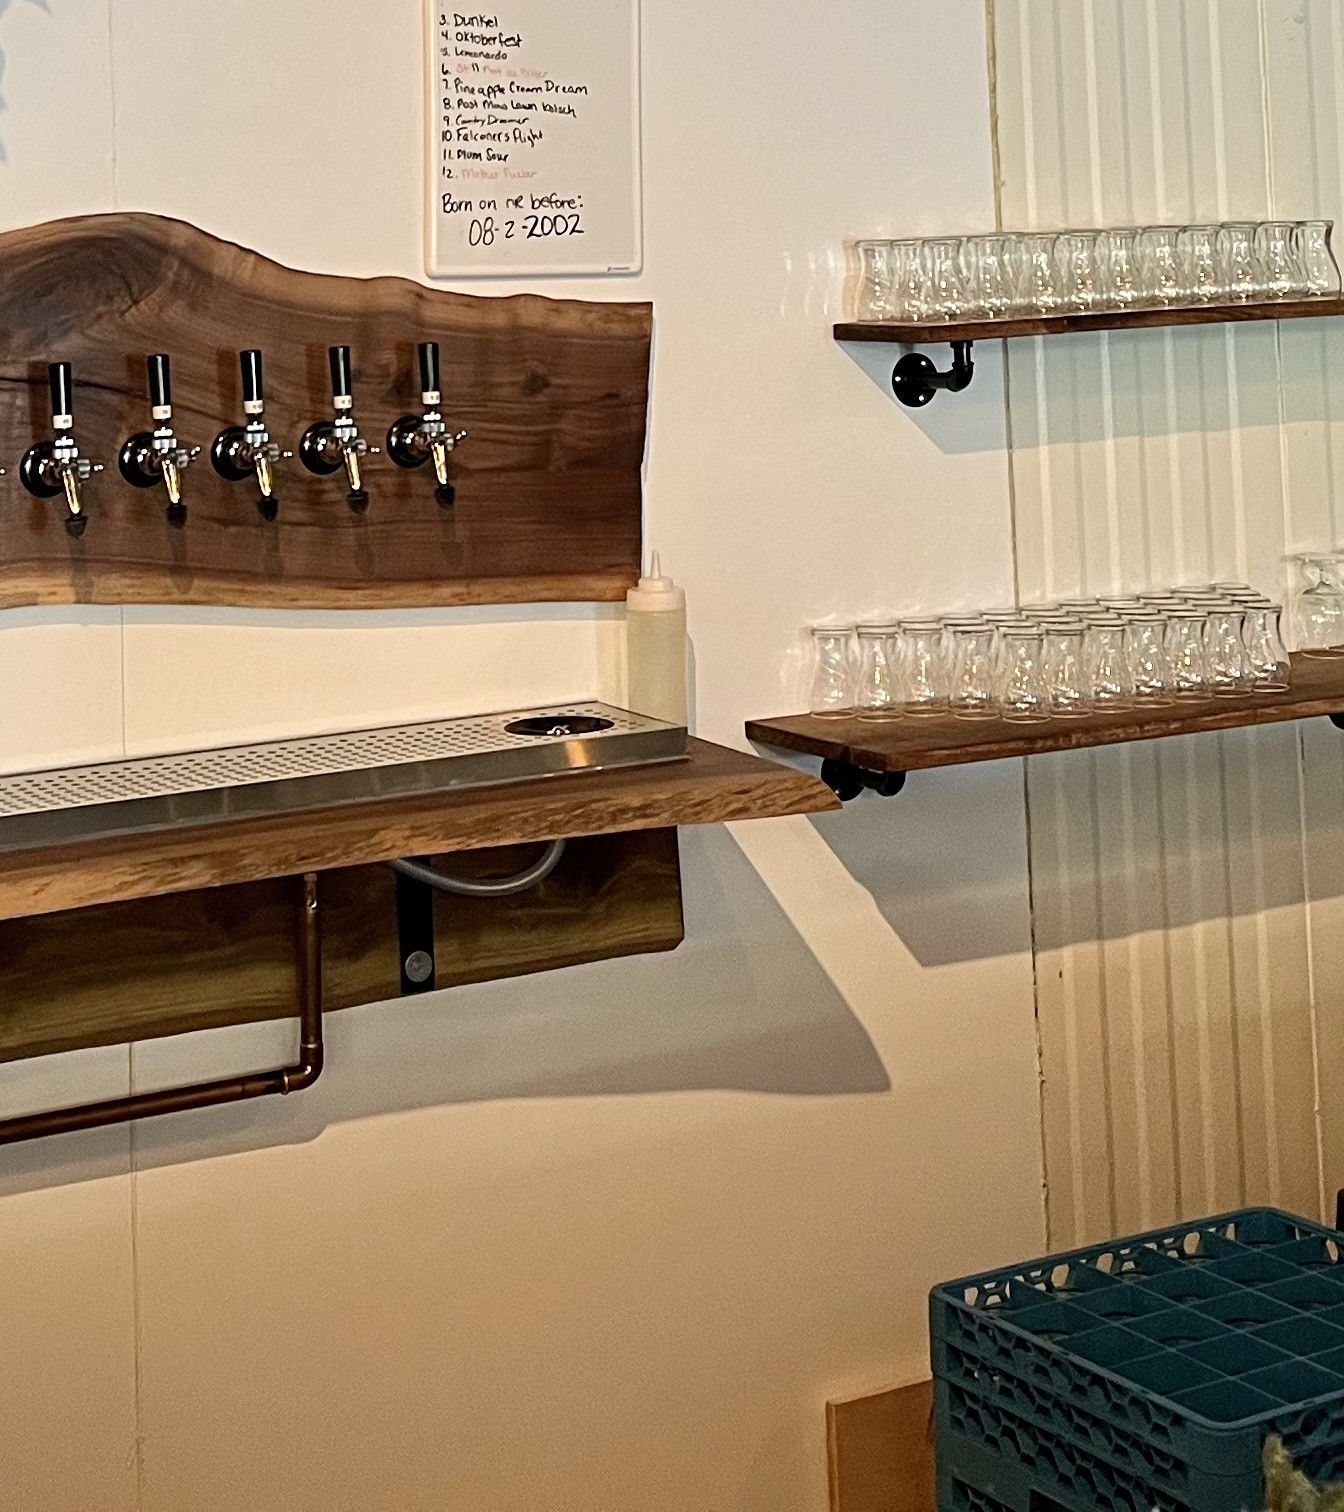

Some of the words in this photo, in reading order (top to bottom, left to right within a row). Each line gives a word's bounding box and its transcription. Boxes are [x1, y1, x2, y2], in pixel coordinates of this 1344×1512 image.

[545, 80, 588, 95] Dream
[457, 149, 482, 161] Plum
[487, 148, 508, 162] Sour
[442, 193, 472, 213] Born
[479, 200, 496, 209] on
